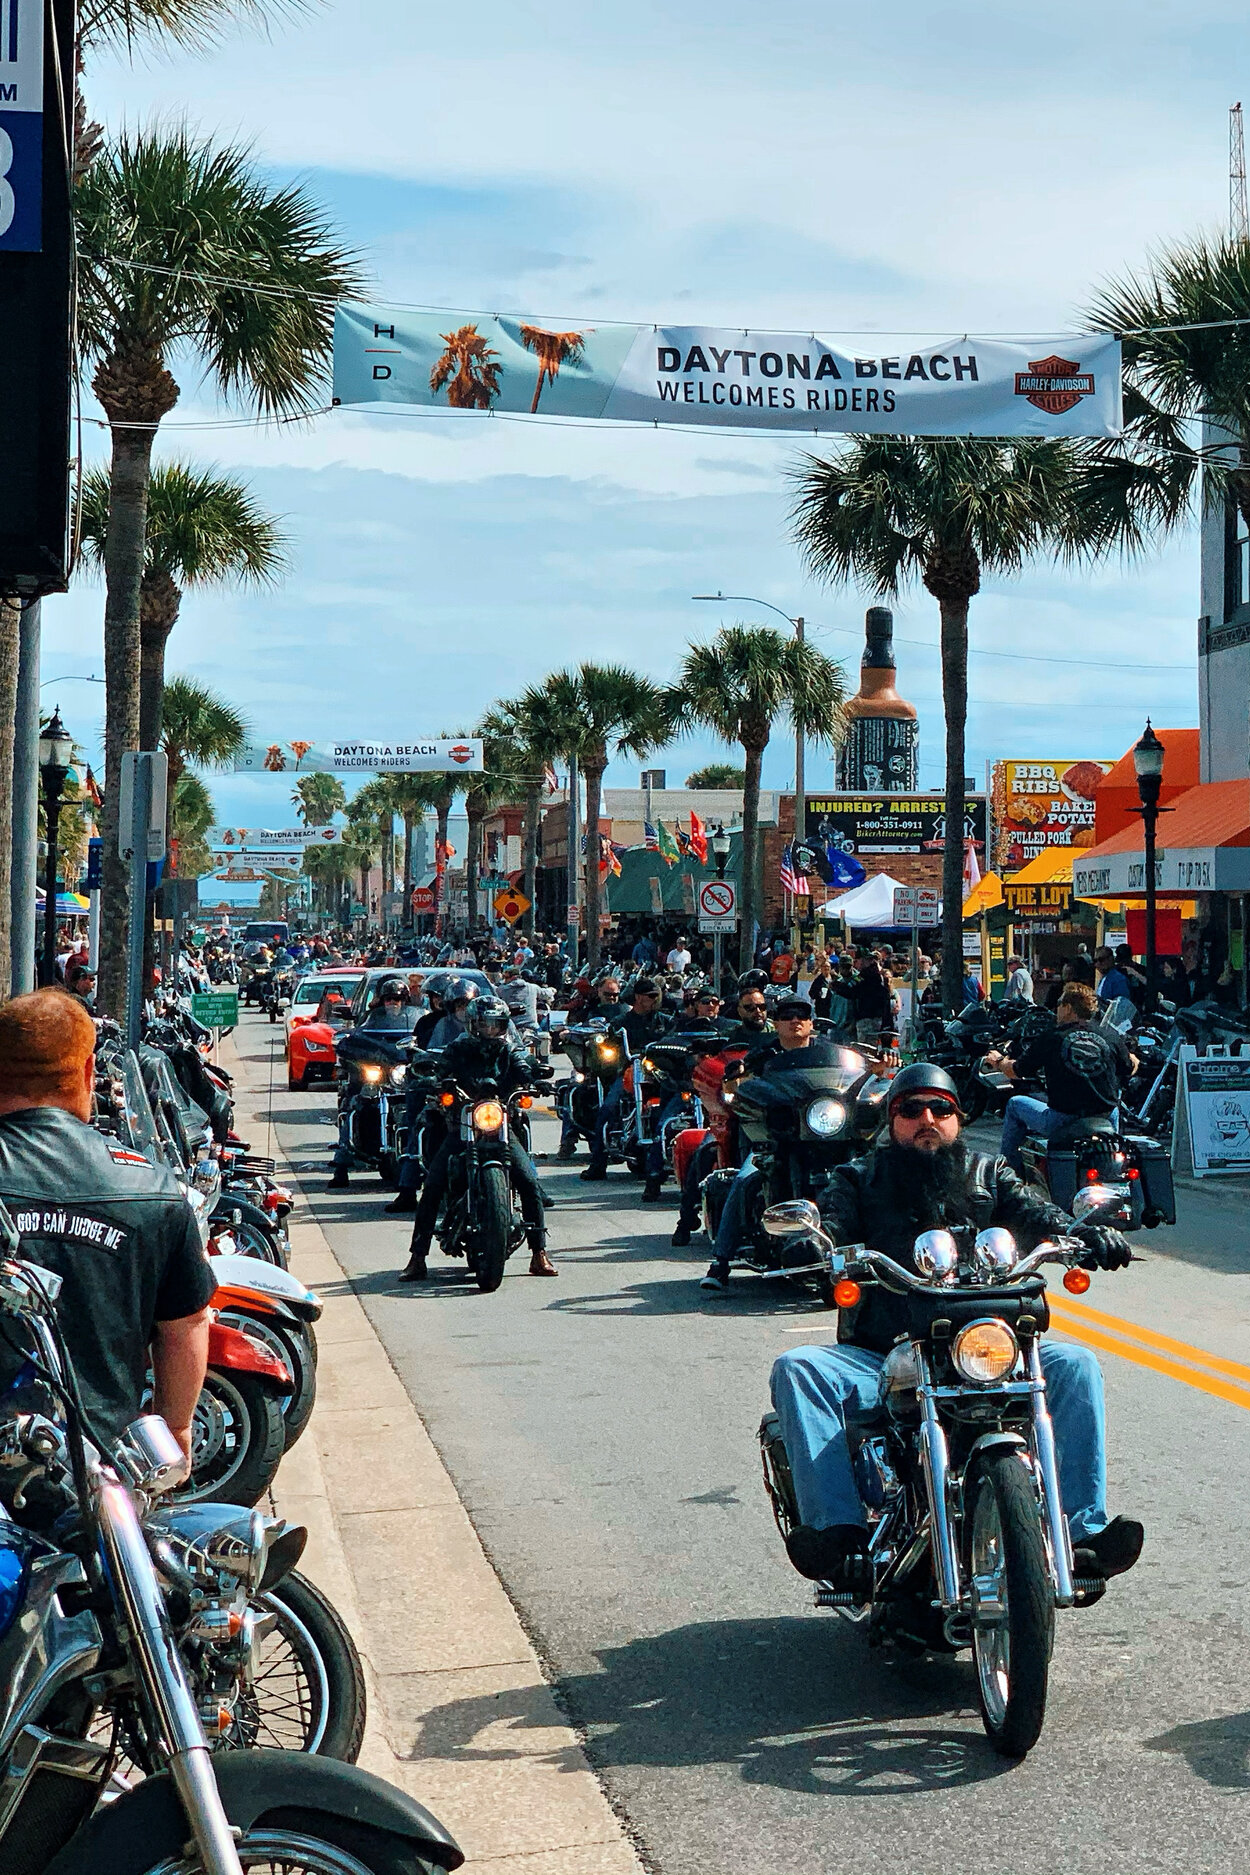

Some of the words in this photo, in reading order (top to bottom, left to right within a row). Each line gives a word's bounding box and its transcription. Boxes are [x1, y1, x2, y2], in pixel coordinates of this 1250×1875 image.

[373, 325, 394, 339] H
[657, 345, 841, 381] DAYTONA
[854, 353, 979, 382] BEACH
[373, 366, 390, 380] D
[1020, 377, 1090, 391] HARLEY-DAVIDSON
[657, 380, 795, 408] WELCOMES
[806, 387, 896, 413] RIDERS
[334, 746, 392, 756] DAYTONA
[396, 746, 437, 755] BEACH
[334, 758, 378, 766] WELCOMES
[381, 757, 410, 766] RIDERS
[1015, 765, 1056, 780] BBQ
[1011, 780, 1060, 793] RIBS
[810, 802, 882, 813] INJURED?
[890, 802, 977, 813] ARREST?
[1051, 801, 1096, 812] BAKE
[856, 821, 922, 829] 1-800-351-0911
[1047, 813, 1095, 824] POTAT
[856, 829, 923, 838] BikerAttorney.com
[1011, 831, 1045, 844] PULLED
[1047, 831, 1071, 844] PORK
[413, 894, 432, 903] STOP
[1005, 887, 1036, 910] THE
[1041, 887, 1072, 910] LOT
[17, 1212, 40, 1232] GOD
[43, 1213, 67, 1234] CAN
[68, 1216, 109, 1242] JUDGE
[104, 1227, 127, 1250] ME
